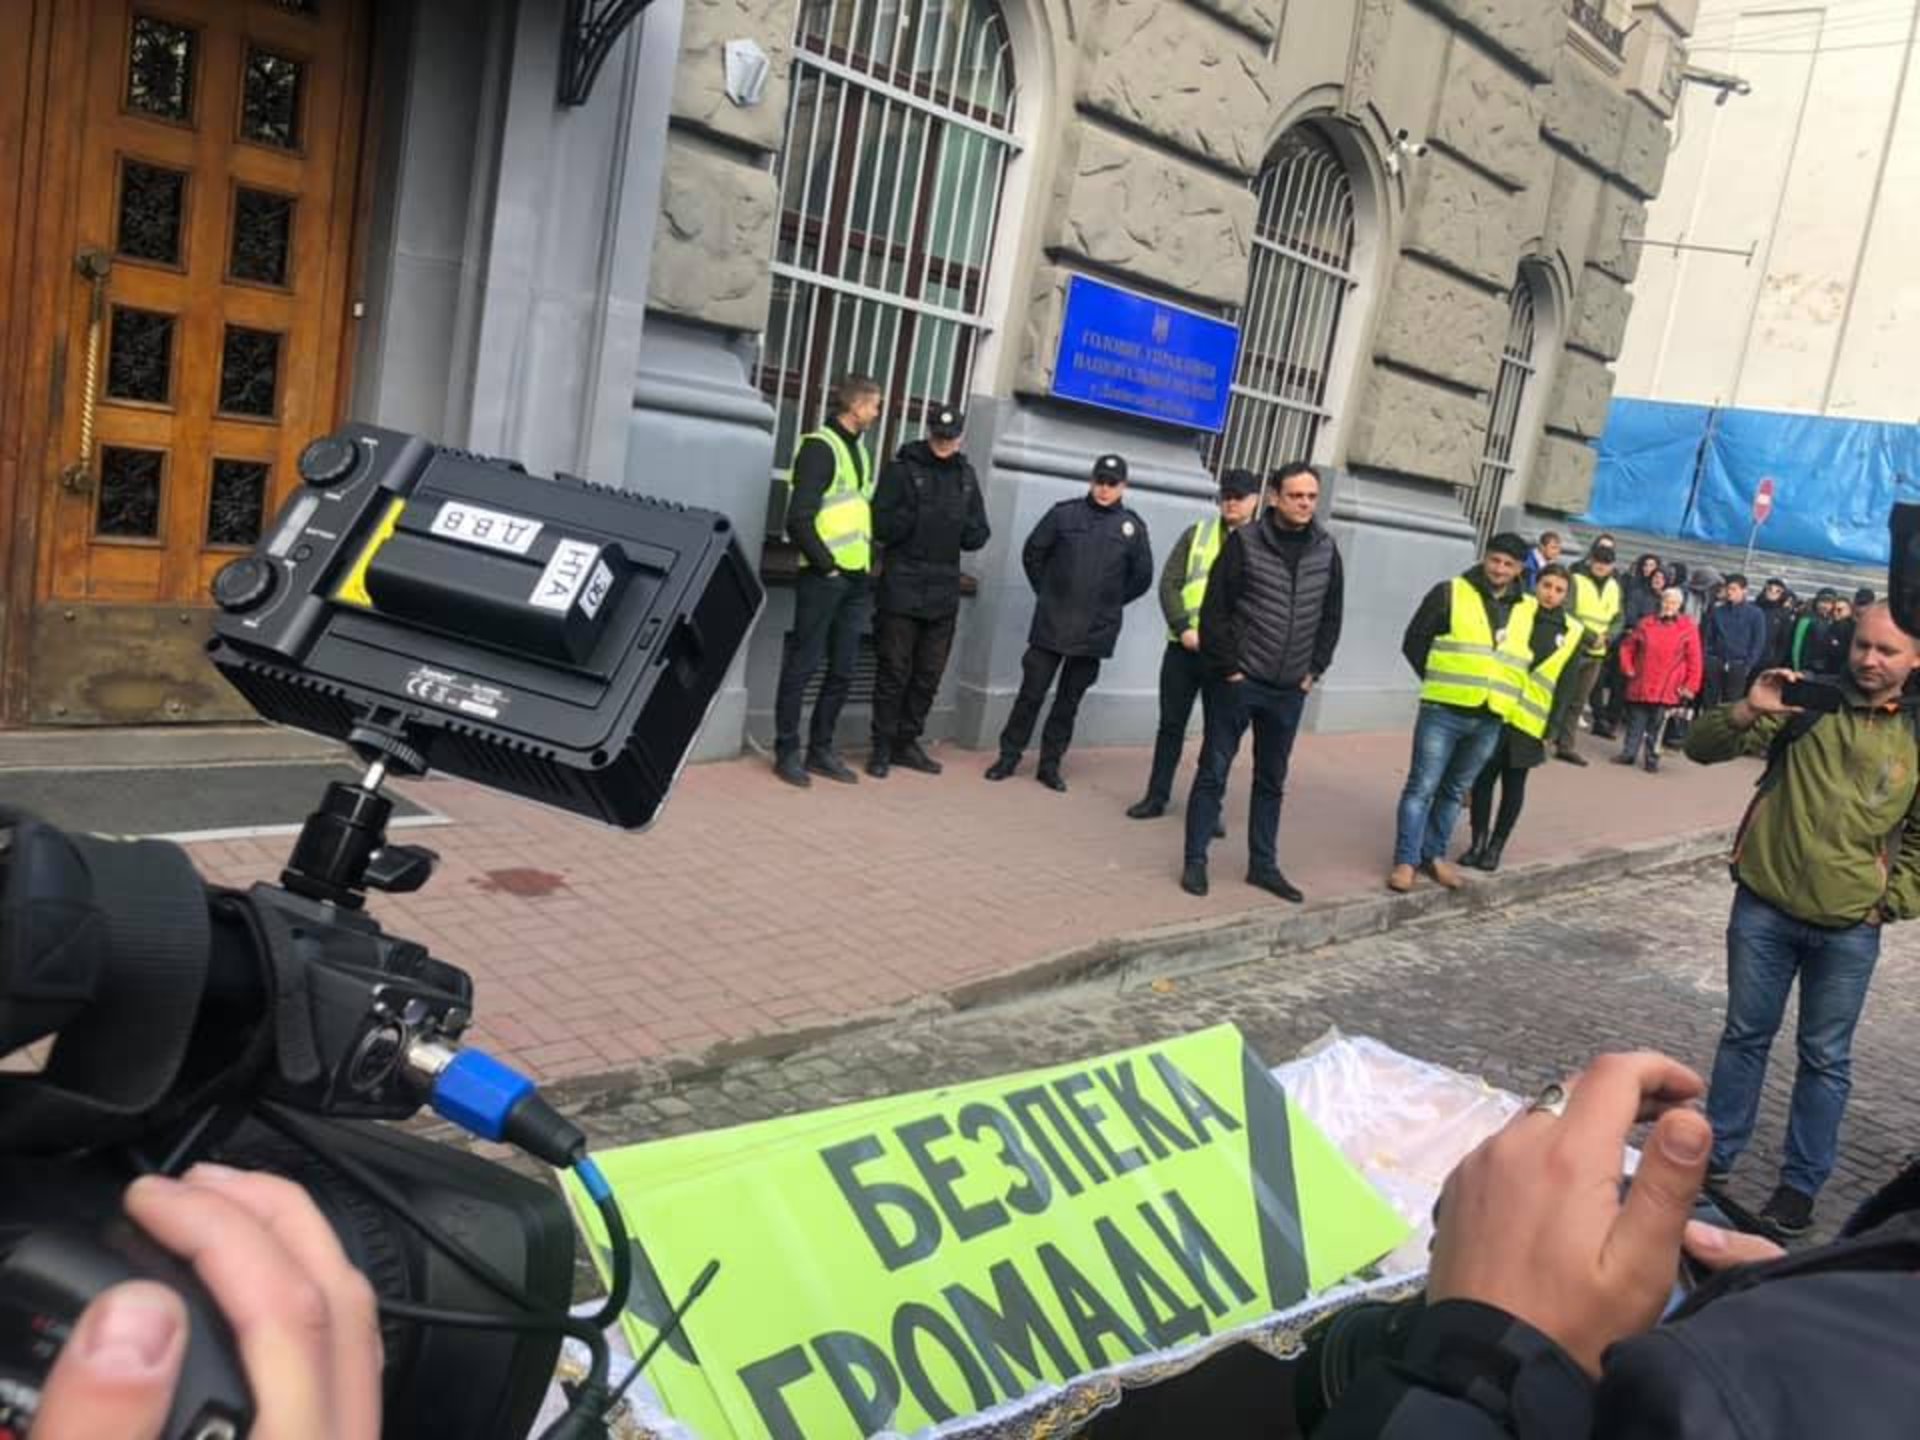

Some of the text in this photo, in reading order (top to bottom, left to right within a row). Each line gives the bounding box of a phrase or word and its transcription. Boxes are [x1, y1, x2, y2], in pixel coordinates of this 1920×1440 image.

[545, 548, 592, 597] НТА
[818, 1052, 1242, 1272] БЕЗПЕКА
[736, 1190, 1257, 1440] ГРОМАДИ
